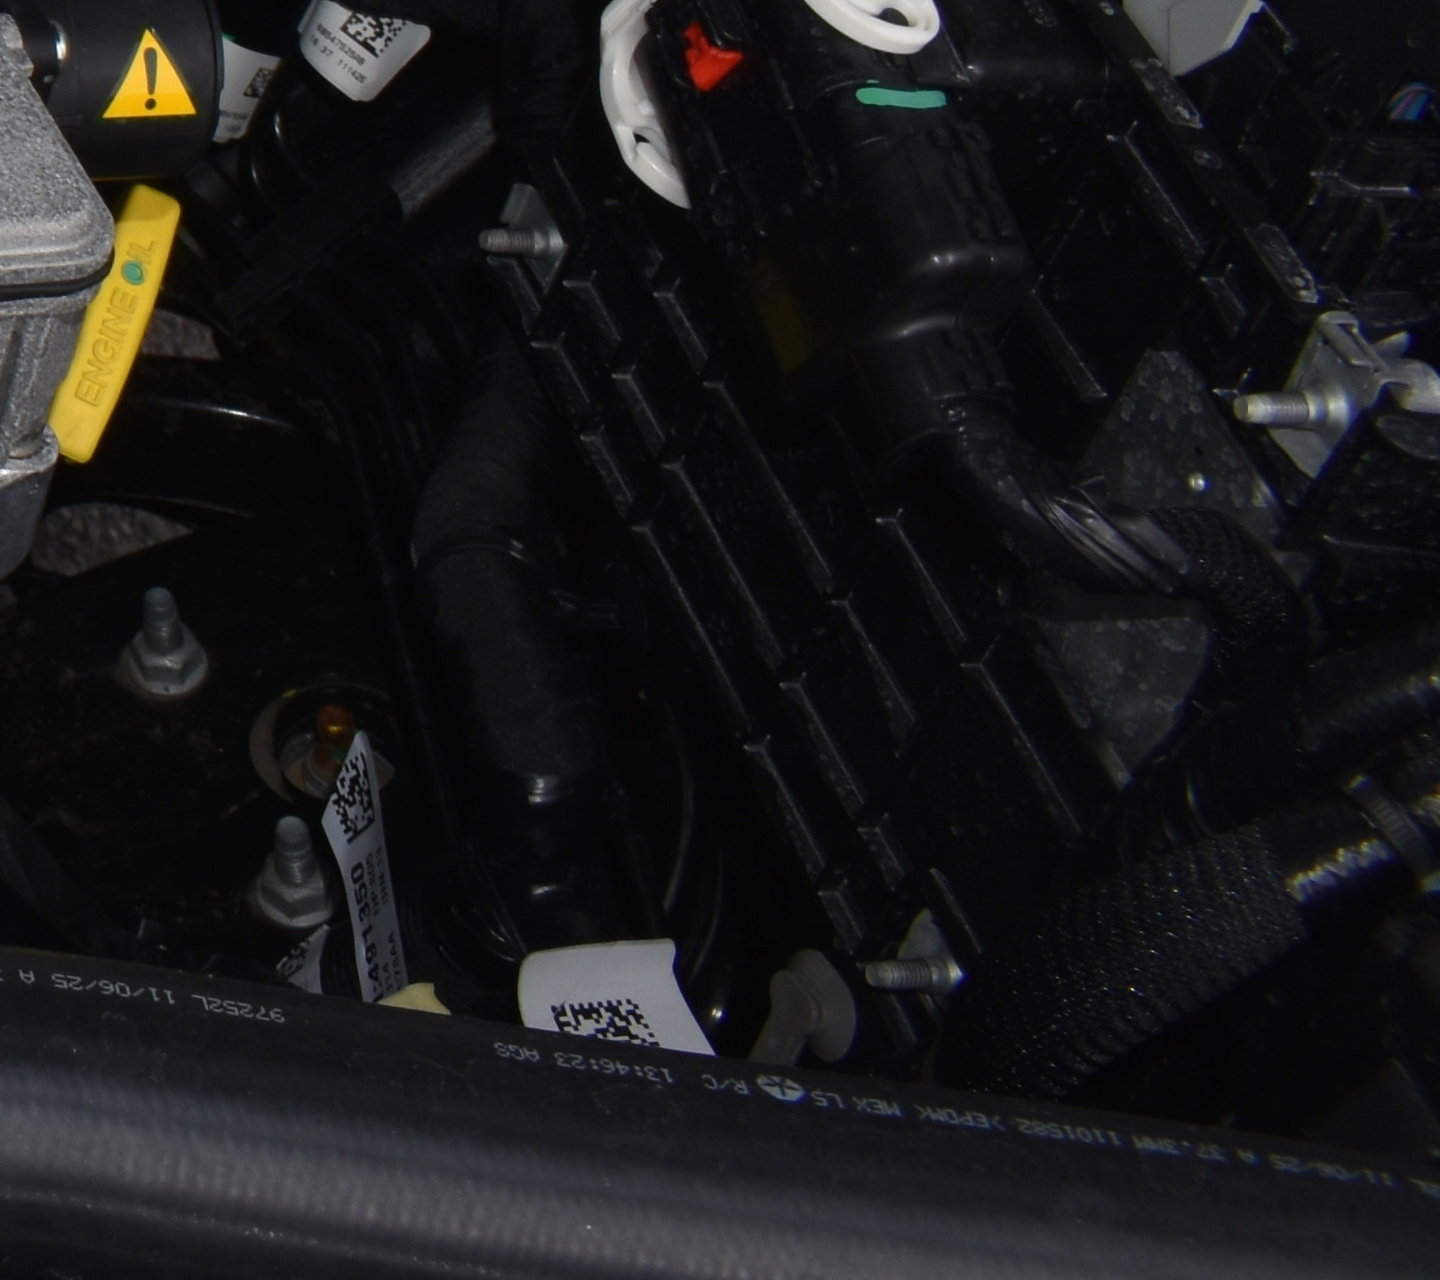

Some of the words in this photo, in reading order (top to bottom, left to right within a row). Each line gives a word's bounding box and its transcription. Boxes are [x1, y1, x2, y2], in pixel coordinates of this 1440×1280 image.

[73, 286, 139, 408] ENGINE
[17, 967, 35, 984] A
[49, 971, 176, 1006] 11/06/25
[191, 993, 287, 1024] 97252L
[492, 1041, 540, 1064] AGS
[552, 1050, 676, 1085] 13:46:23
[700, 1073, 751, 1096] R/C
[809, 1088, 844, 1110] L5
[851, 1095, 905, 1119] MEX
